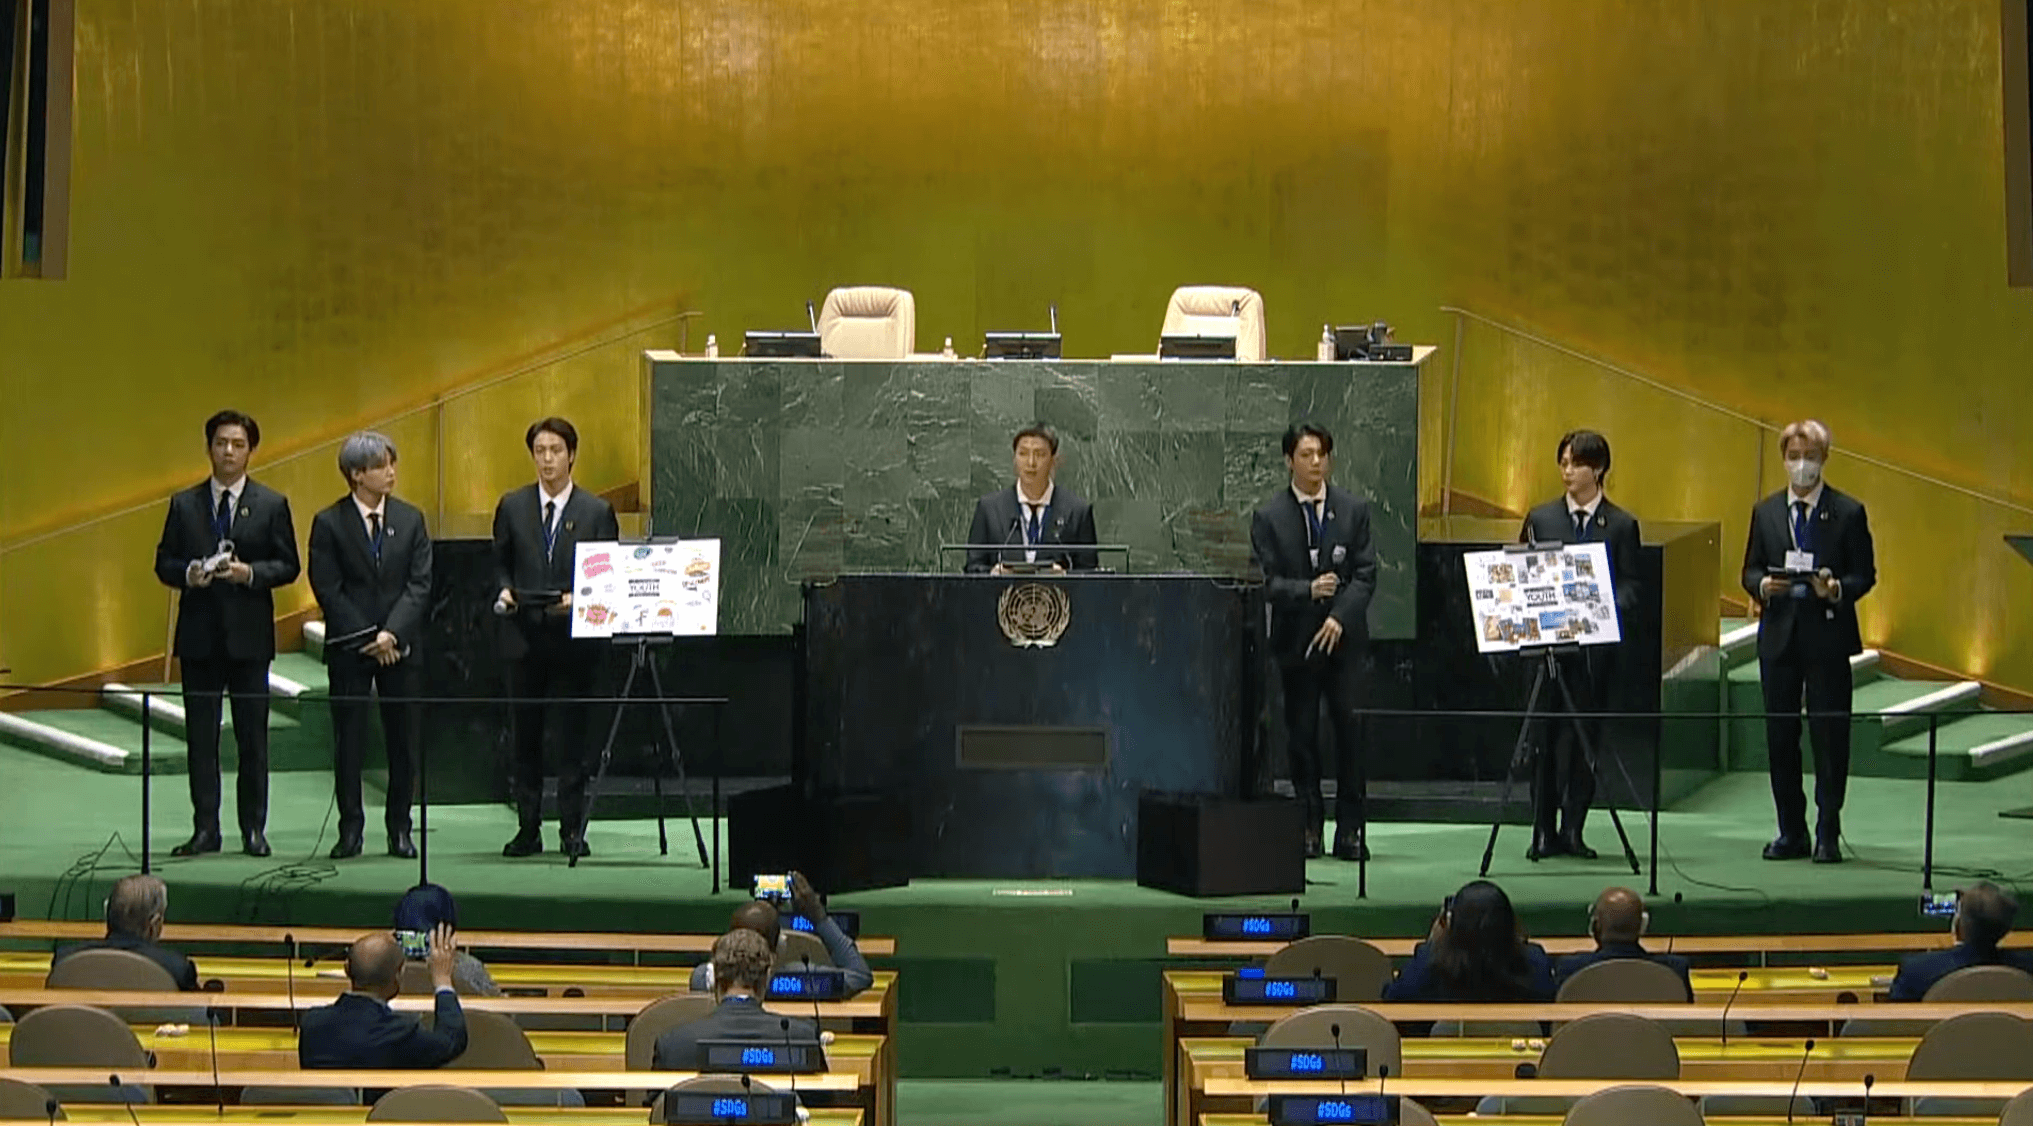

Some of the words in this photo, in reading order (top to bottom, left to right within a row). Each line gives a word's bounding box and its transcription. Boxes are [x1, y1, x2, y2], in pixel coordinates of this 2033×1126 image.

[1525, 591, 1556, 601] YOUTH
[1243, 917, 1270, 933] #SDGs
[773, 977, 802, 992] #SDGs
[1265, 981, 1295, 997] #SDGs
[743, 1047, 774, 1064] #SDGs
[1291, 1053, 1322, 1070] #SDGs
[713, 1098, 747, 1116] #SDGs
[1317, 1101, 1352, 1118] #SDGs
